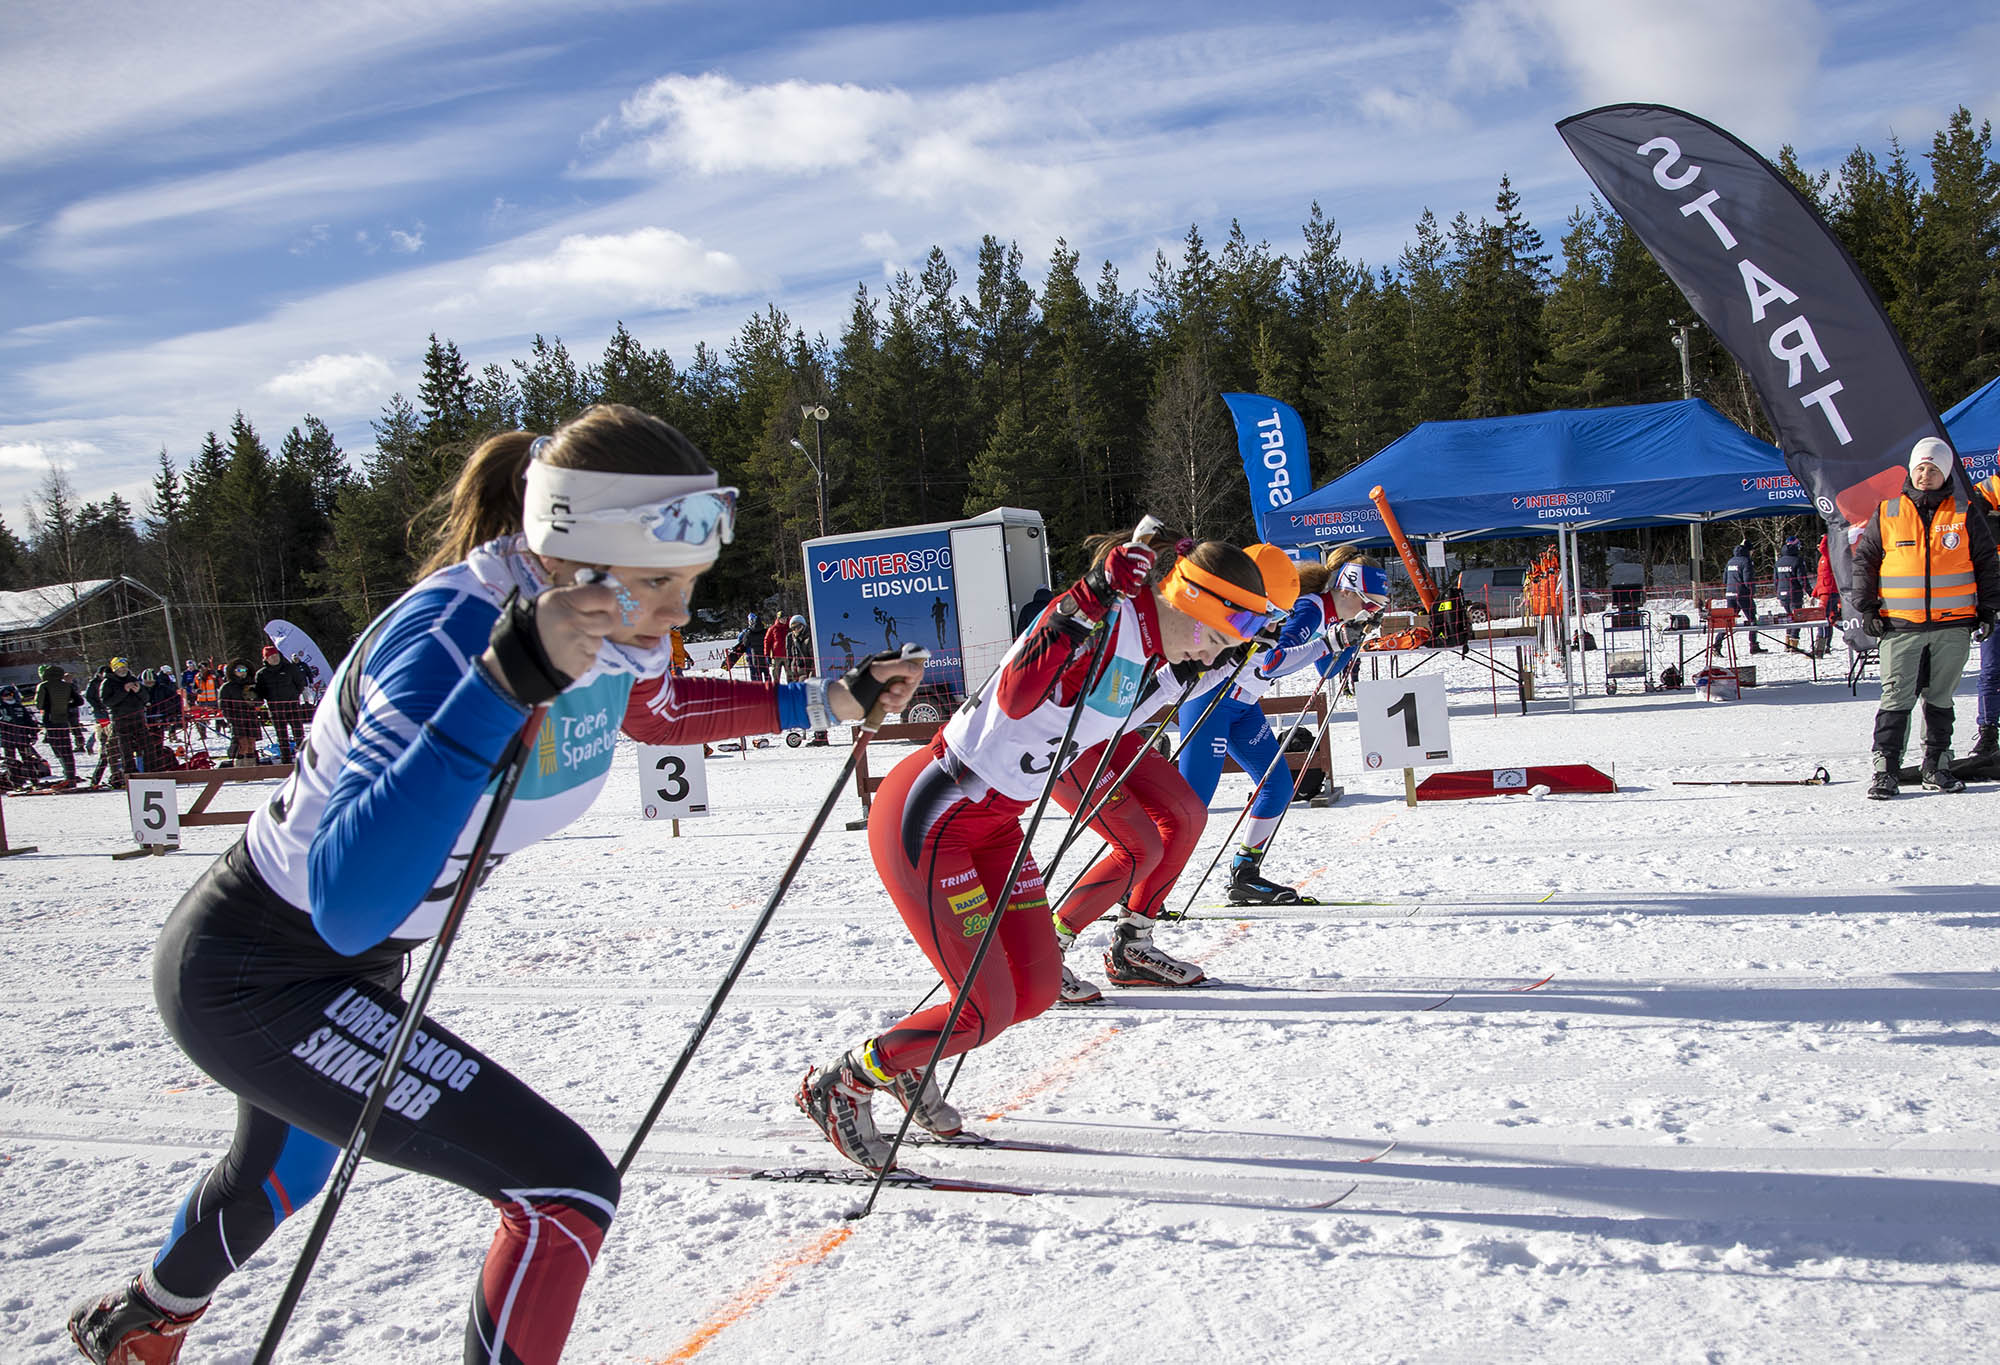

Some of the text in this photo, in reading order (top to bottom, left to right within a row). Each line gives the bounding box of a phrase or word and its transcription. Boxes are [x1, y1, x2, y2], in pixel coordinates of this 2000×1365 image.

[1526, 489, 1613, 509] INTERSPORT
[1538, 506, 1591, 519] EIDSVOLL
[1315, 524, 1365, 536] EIDSVOLL
[1935, 522, 1964, 533] START
[862, 575, 949, 599] EIDSVOLL
[1387, 692, 1421, 747] 1
[655, 756, 690, 802] 3
[143, 791, 167, 829] 5
